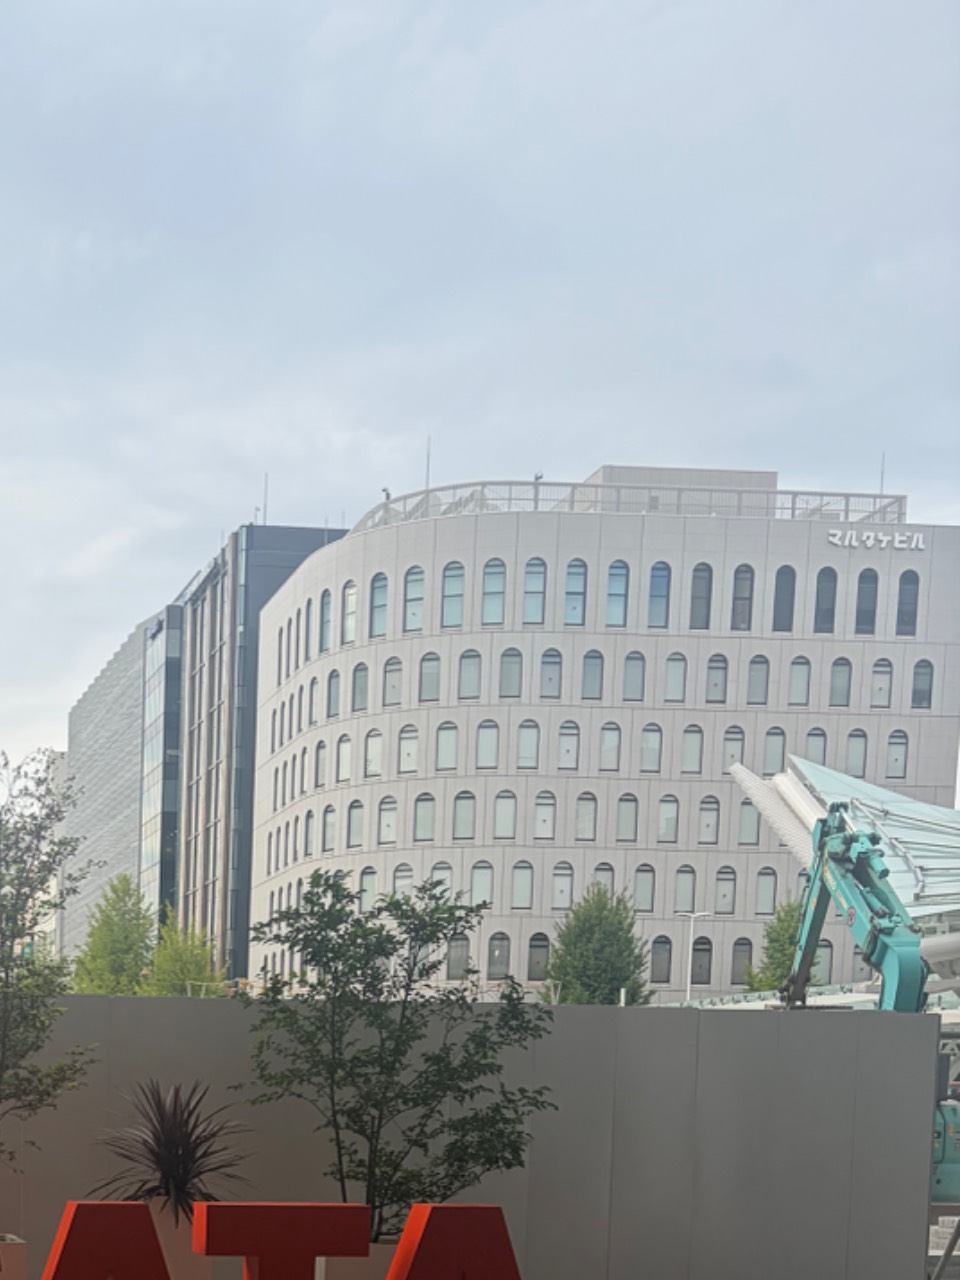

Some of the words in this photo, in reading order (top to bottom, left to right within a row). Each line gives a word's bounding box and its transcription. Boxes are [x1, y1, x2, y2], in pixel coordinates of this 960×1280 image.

[827, 529, 926, 551] マルタケビル
